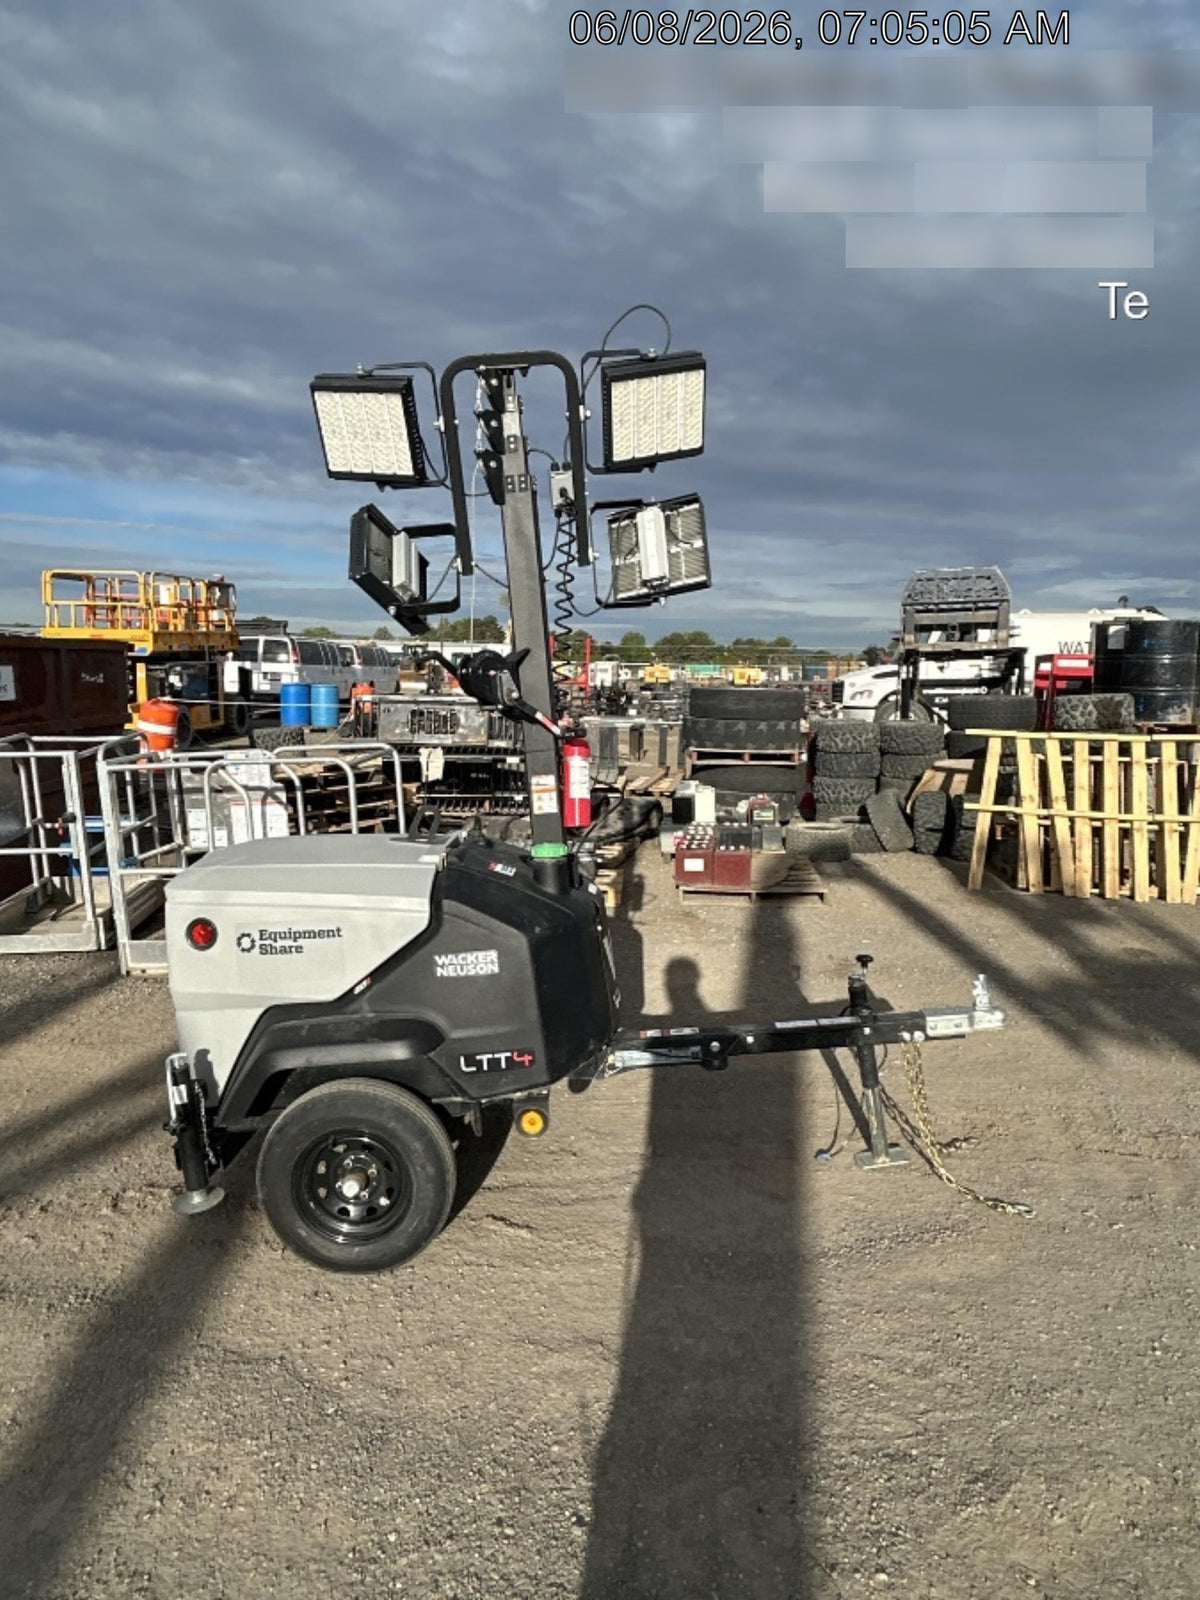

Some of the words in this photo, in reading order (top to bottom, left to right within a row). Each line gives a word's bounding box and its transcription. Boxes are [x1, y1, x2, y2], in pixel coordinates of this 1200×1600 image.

[258, 927, 343, 943] Equipment
[258, 943, 304, 956] Share
[433, 949, 499, 966] WACKER
[436, 963, 499, 977] NEUSON
[460, 1051, 533, 1072] LTT4
